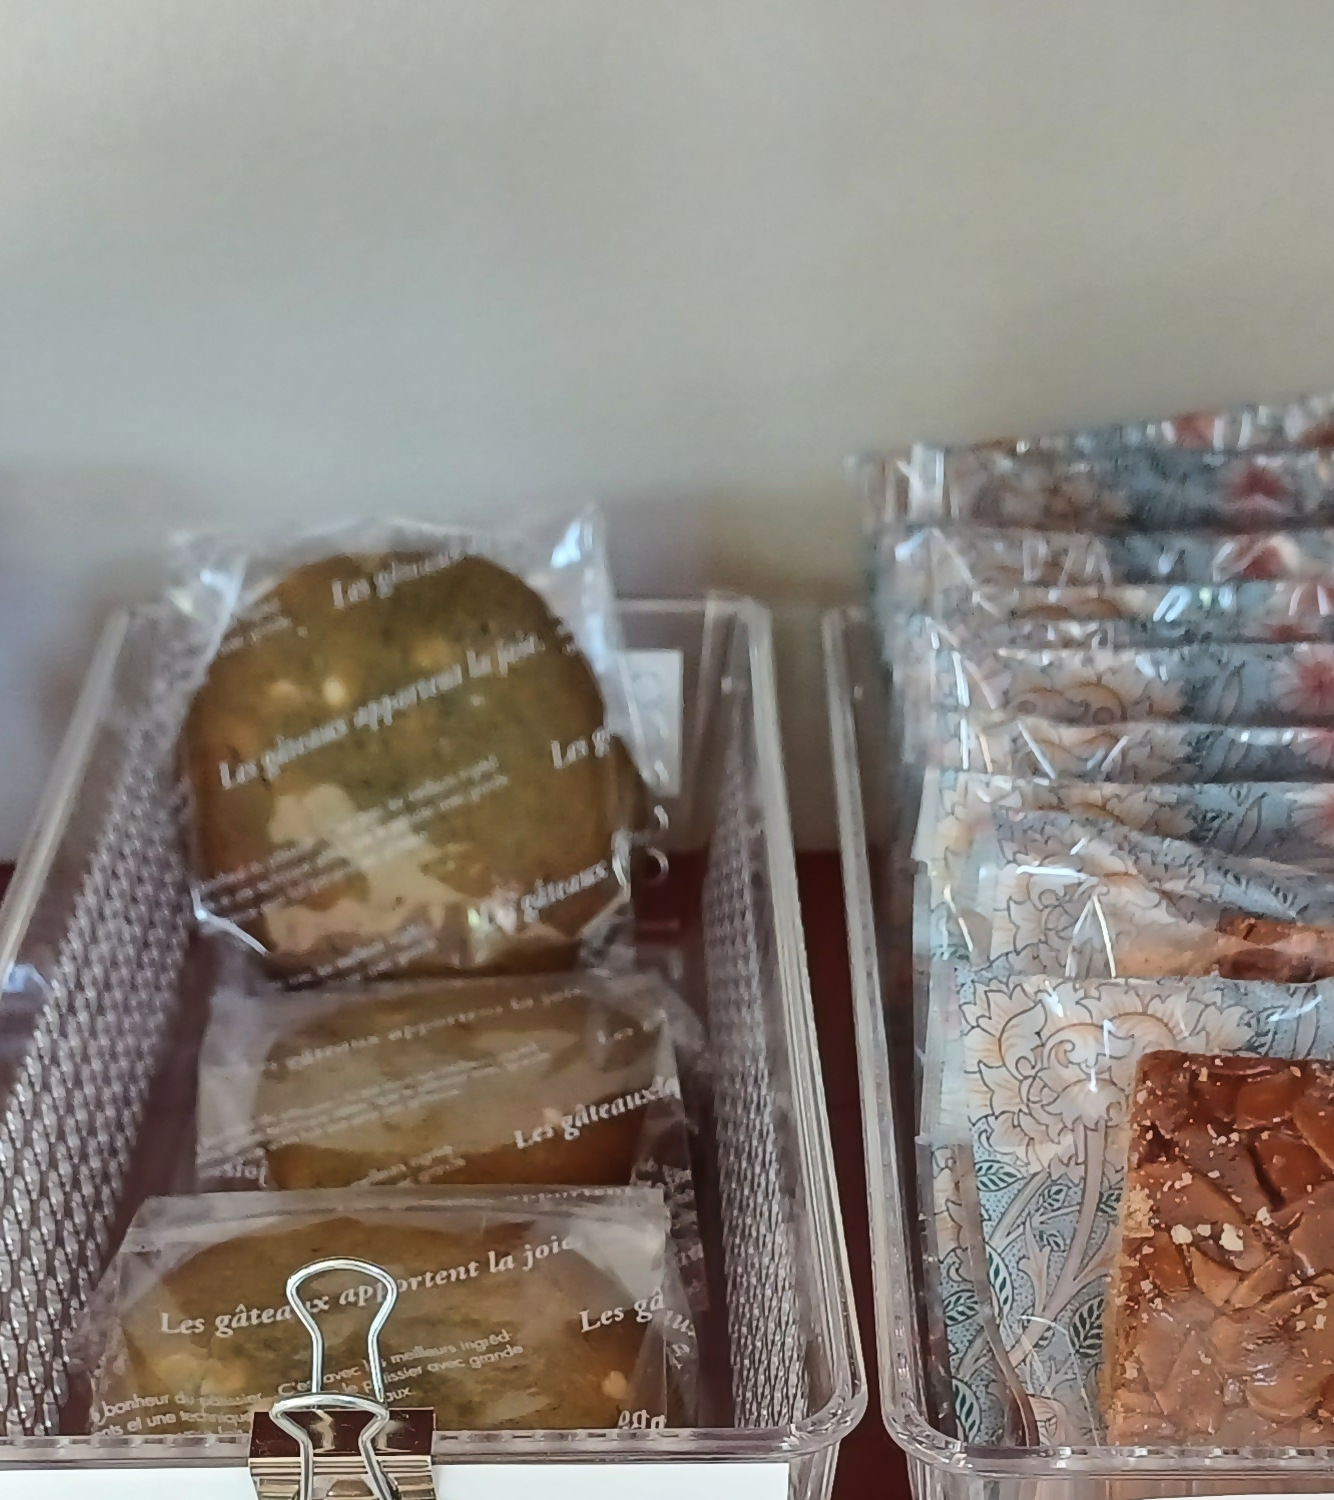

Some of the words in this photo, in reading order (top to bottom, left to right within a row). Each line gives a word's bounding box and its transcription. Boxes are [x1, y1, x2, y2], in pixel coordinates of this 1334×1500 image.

[160, 1312, 205, 1336] Les
[487, 1250, 515, 1274] la
[578, 1303, 625, 1334] Les
